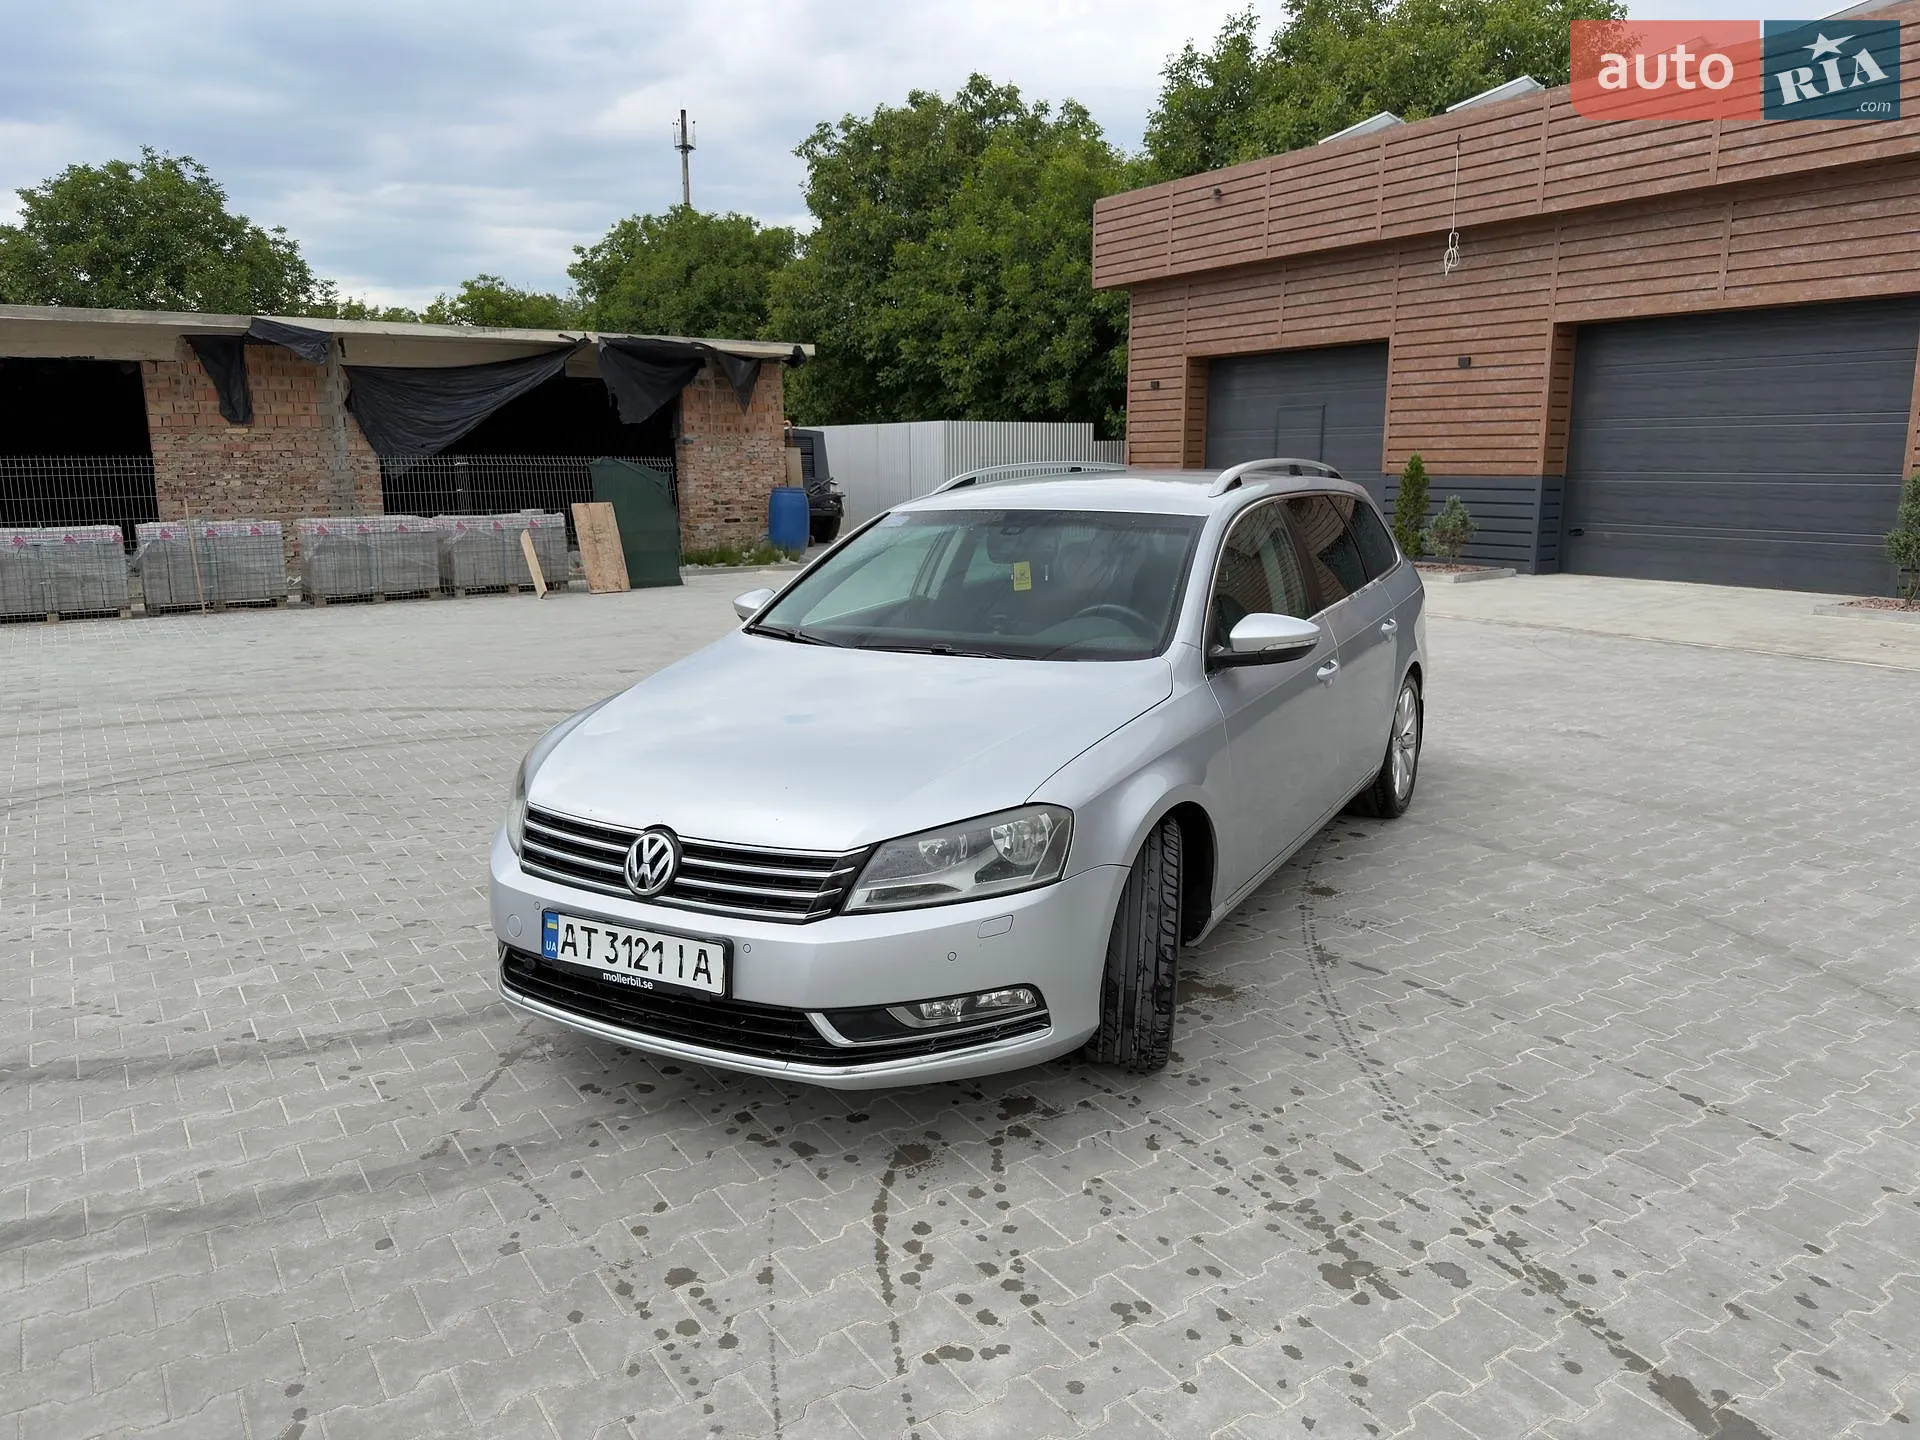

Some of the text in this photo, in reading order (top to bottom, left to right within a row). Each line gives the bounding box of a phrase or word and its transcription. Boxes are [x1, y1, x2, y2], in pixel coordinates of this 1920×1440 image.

[546, 940, 557, 952] UA
[560, 923, 712, 985] AT 3121 IA
[602, 971, 654, 990] mollerbil.se
